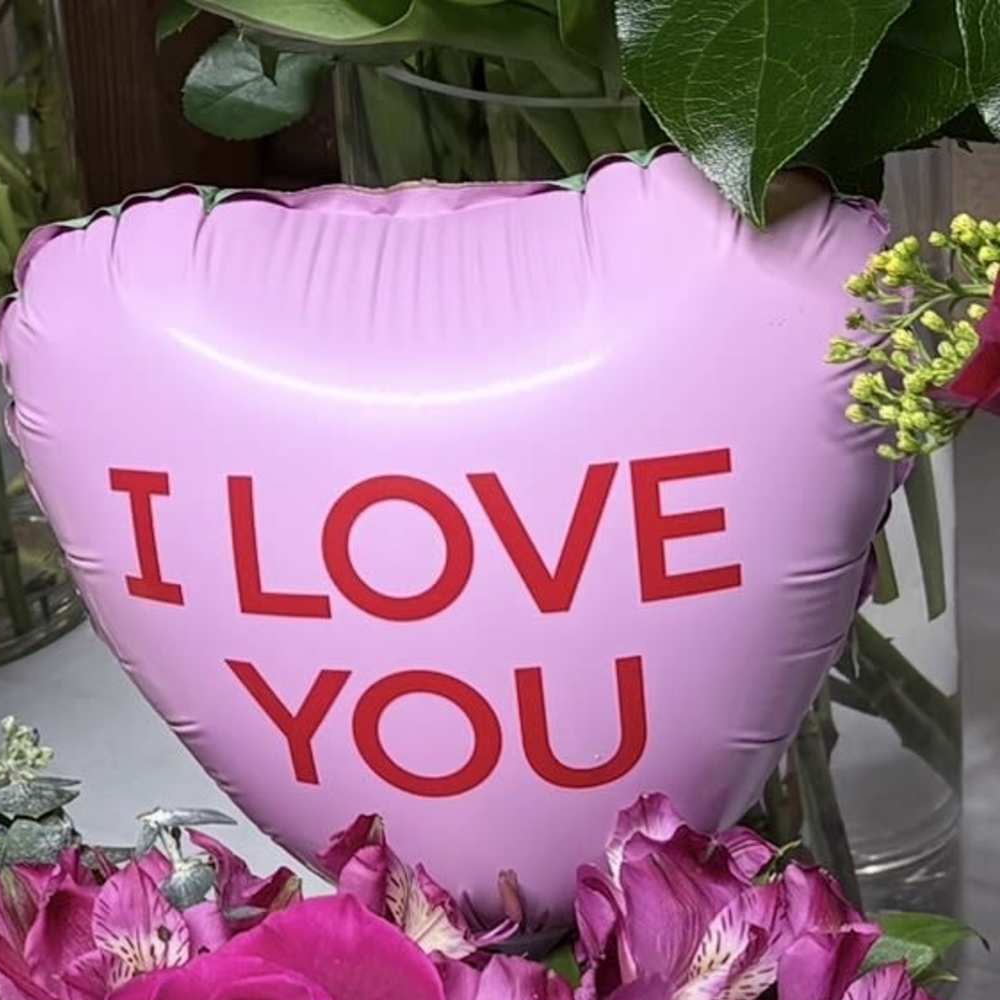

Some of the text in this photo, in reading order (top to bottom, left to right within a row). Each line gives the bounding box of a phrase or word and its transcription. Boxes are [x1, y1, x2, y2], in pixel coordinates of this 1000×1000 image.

[108, 447, 744, 624] I LOVE
[225, 656, 649, 800] YOU
